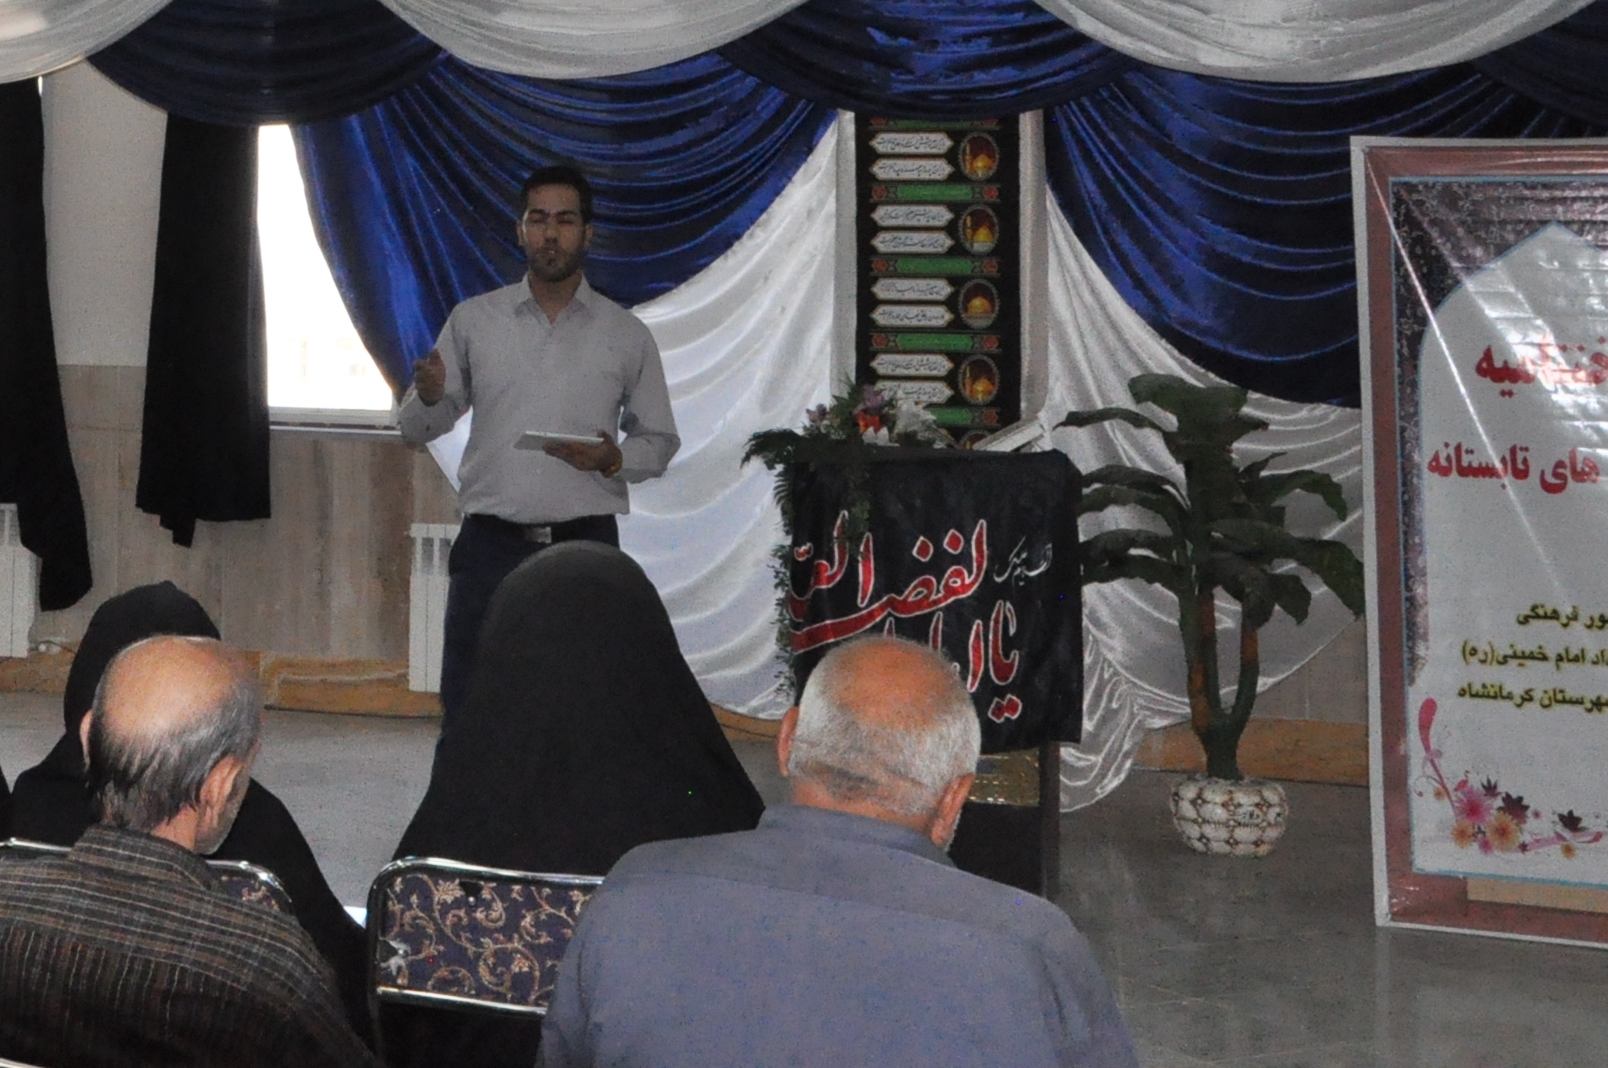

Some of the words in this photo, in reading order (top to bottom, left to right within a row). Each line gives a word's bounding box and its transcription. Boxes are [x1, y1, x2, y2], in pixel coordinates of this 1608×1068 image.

[1427, 441, 1530, 490] تابستانه
[1516, 603, 1580, 628] فرهنگی
[1555, 645, 1586, 670] امام
[1458, 682, 1535, 708] کرمانشاه
